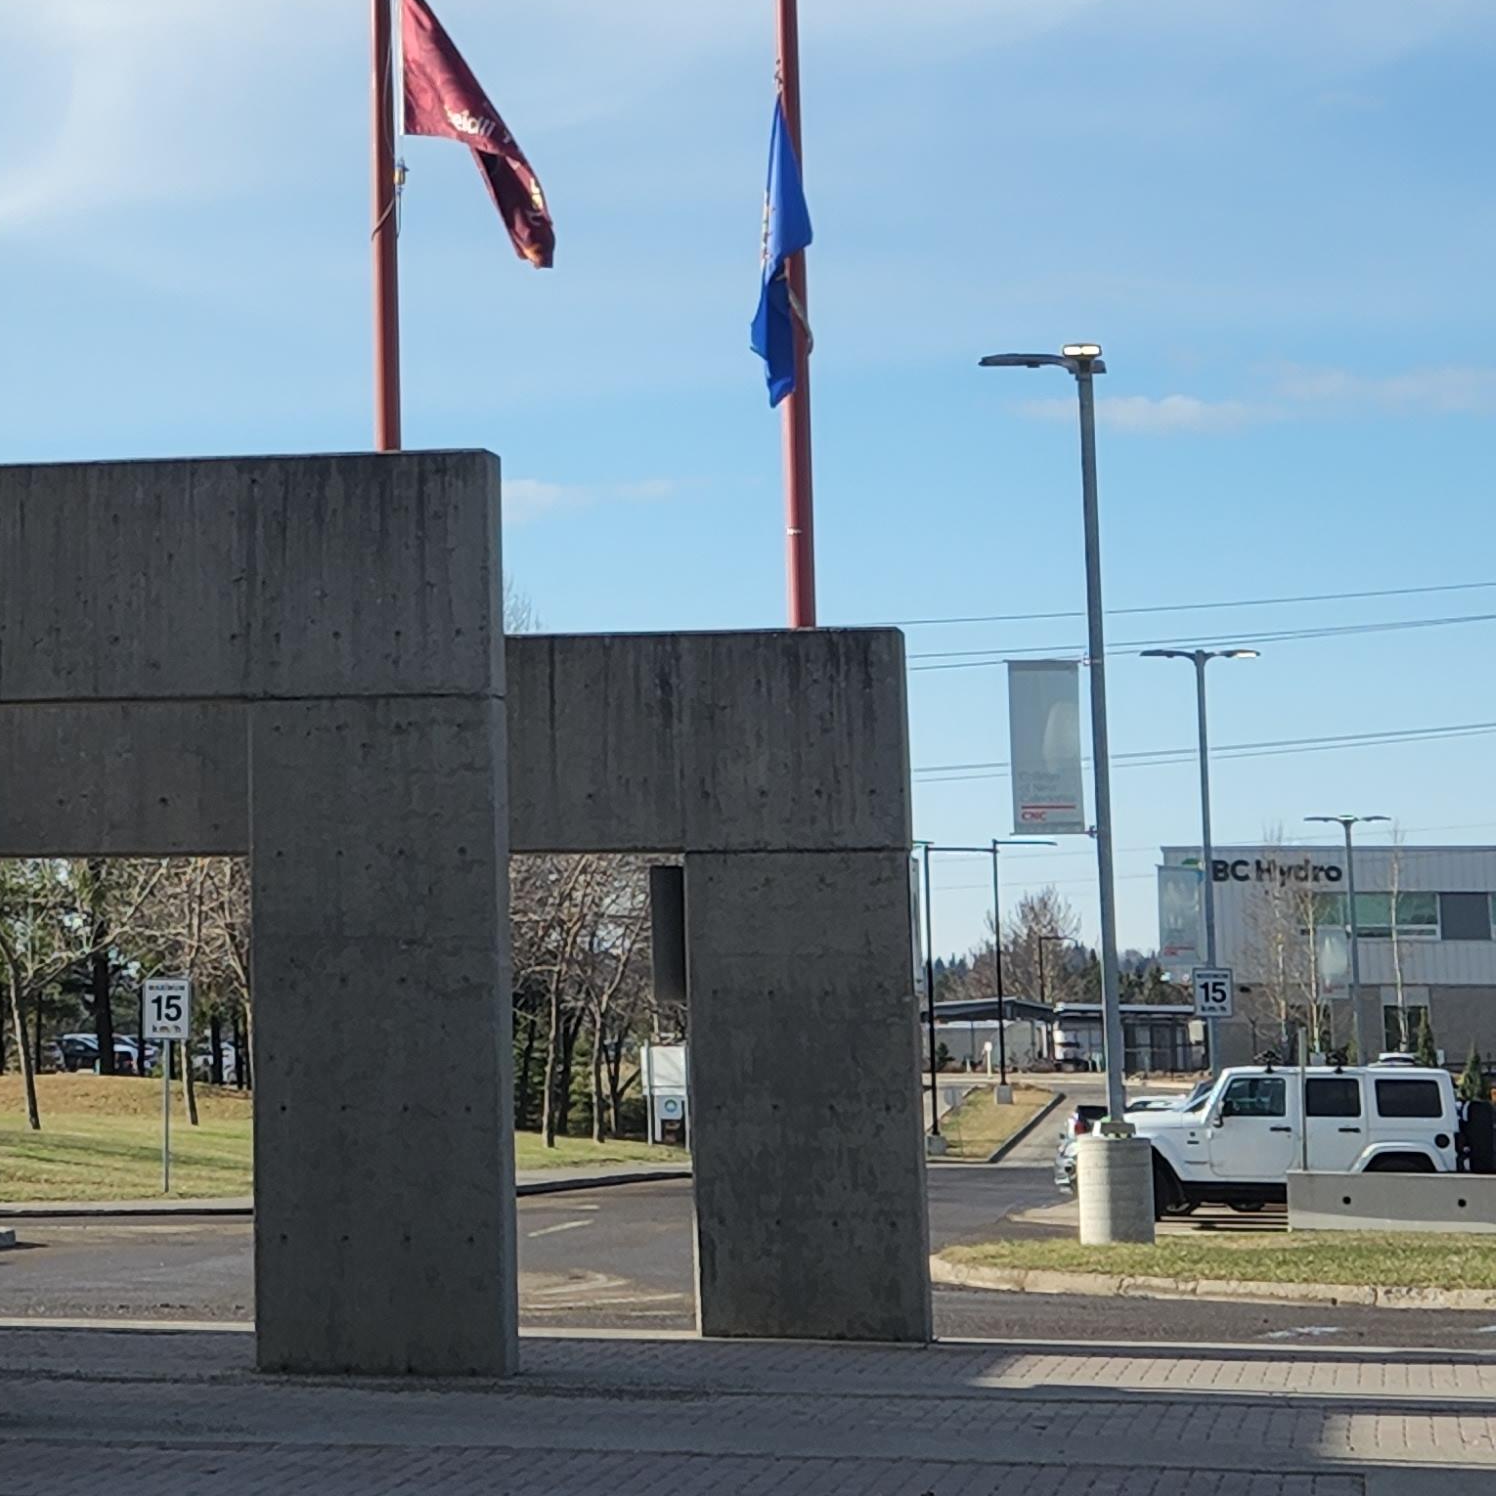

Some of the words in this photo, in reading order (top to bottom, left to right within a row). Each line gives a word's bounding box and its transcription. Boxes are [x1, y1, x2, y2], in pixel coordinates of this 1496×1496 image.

[1211, 859, 1250, 882] BC
[1255, 858, 1342, 888] Hydro
[1199, 981, 1227, 1003] 15
[151, 994, 183, 1022] 15
